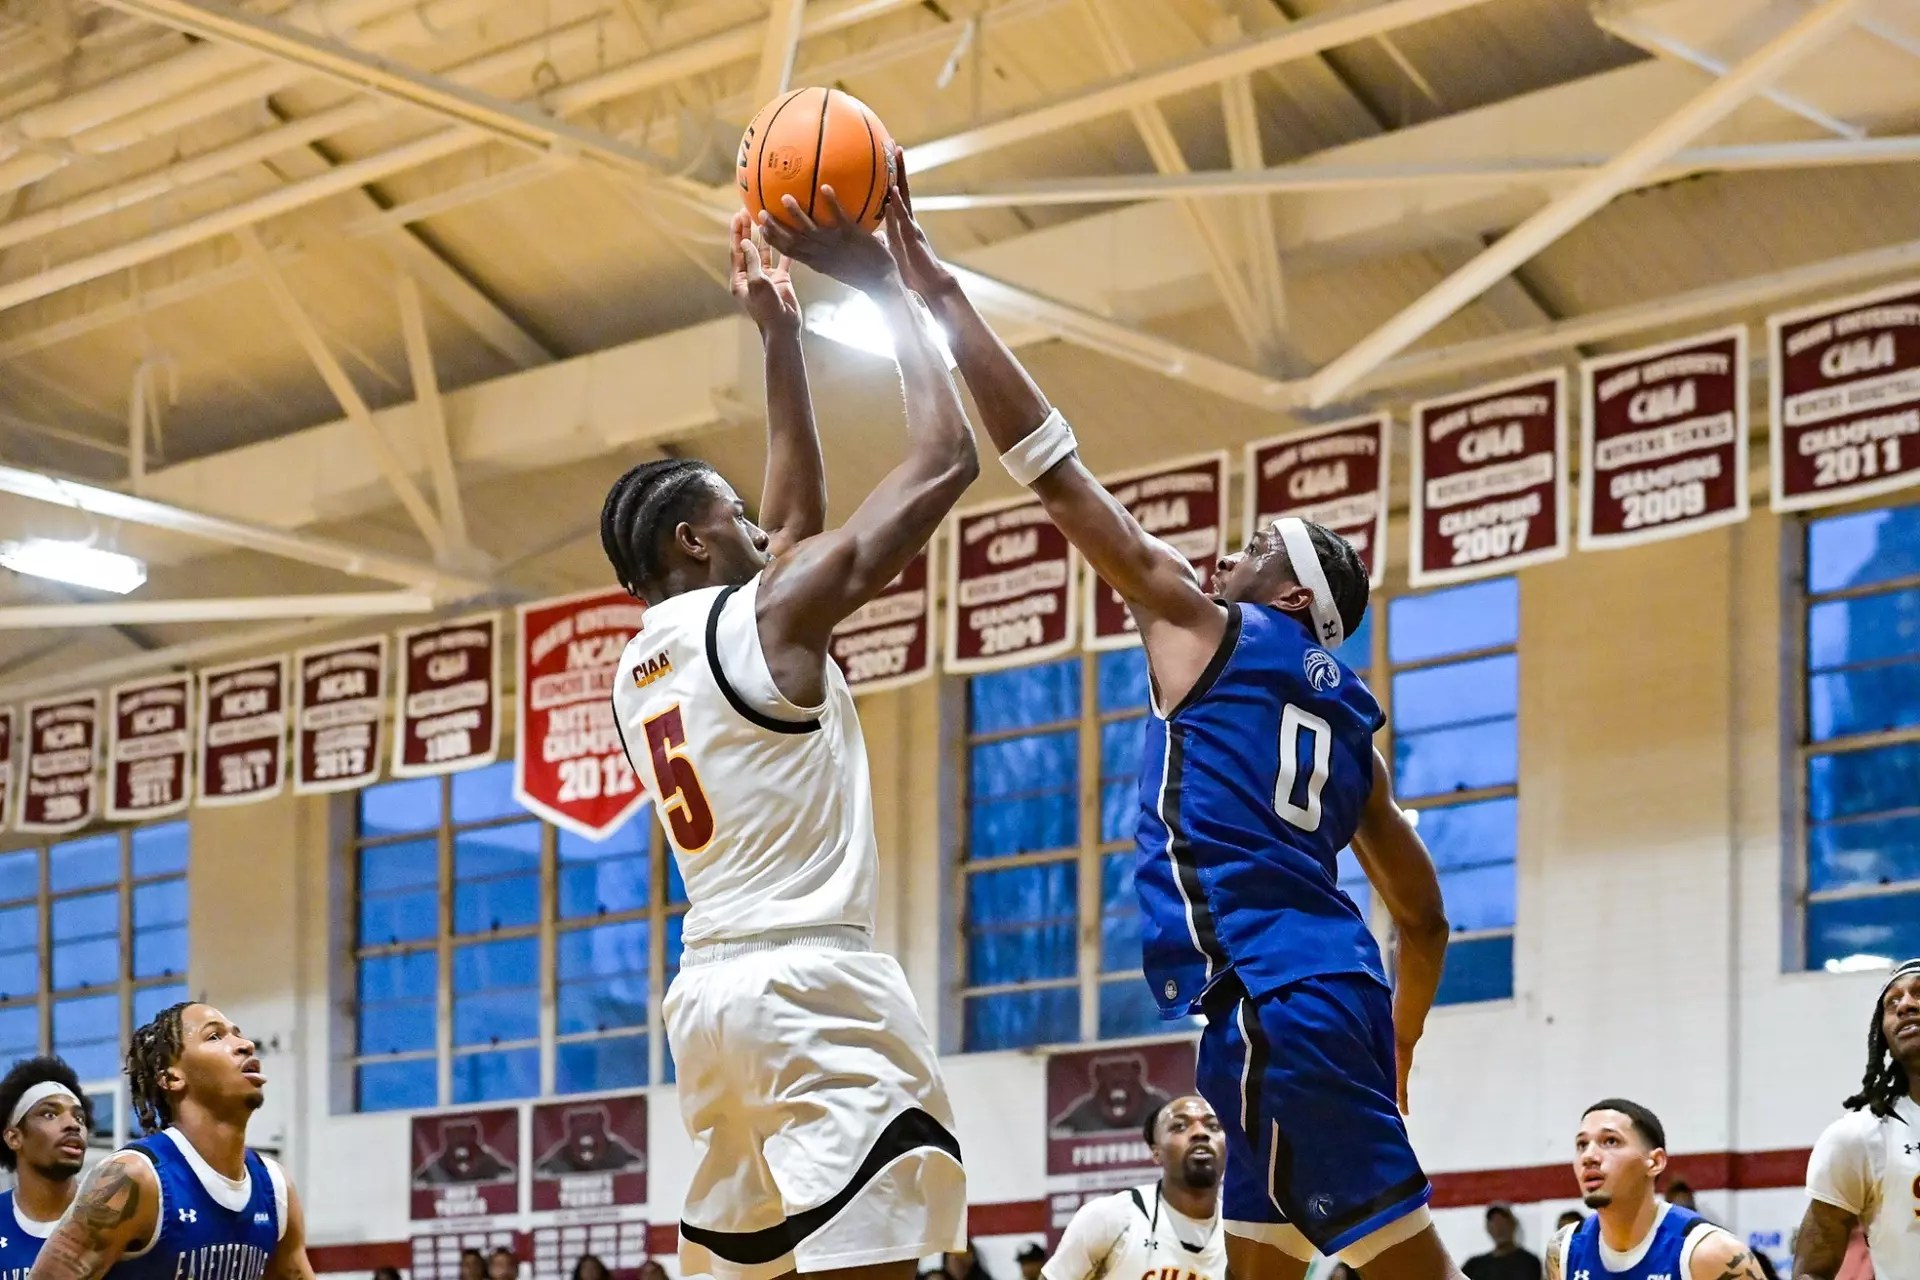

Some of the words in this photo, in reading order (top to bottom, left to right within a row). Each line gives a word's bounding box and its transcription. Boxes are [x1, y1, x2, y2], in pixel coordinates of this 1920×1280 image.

[1813, 437, 1901, 487] 2011
[1621, 481, 1706, 530] 2009
[1452, 518, 1530, 565] 2007
[632, 651, 673, 689] CIAA
[557, 751, 636, 803] 2012
[643, 700, 717, 855] 5
[1274, 702, 1332, 832] 0
